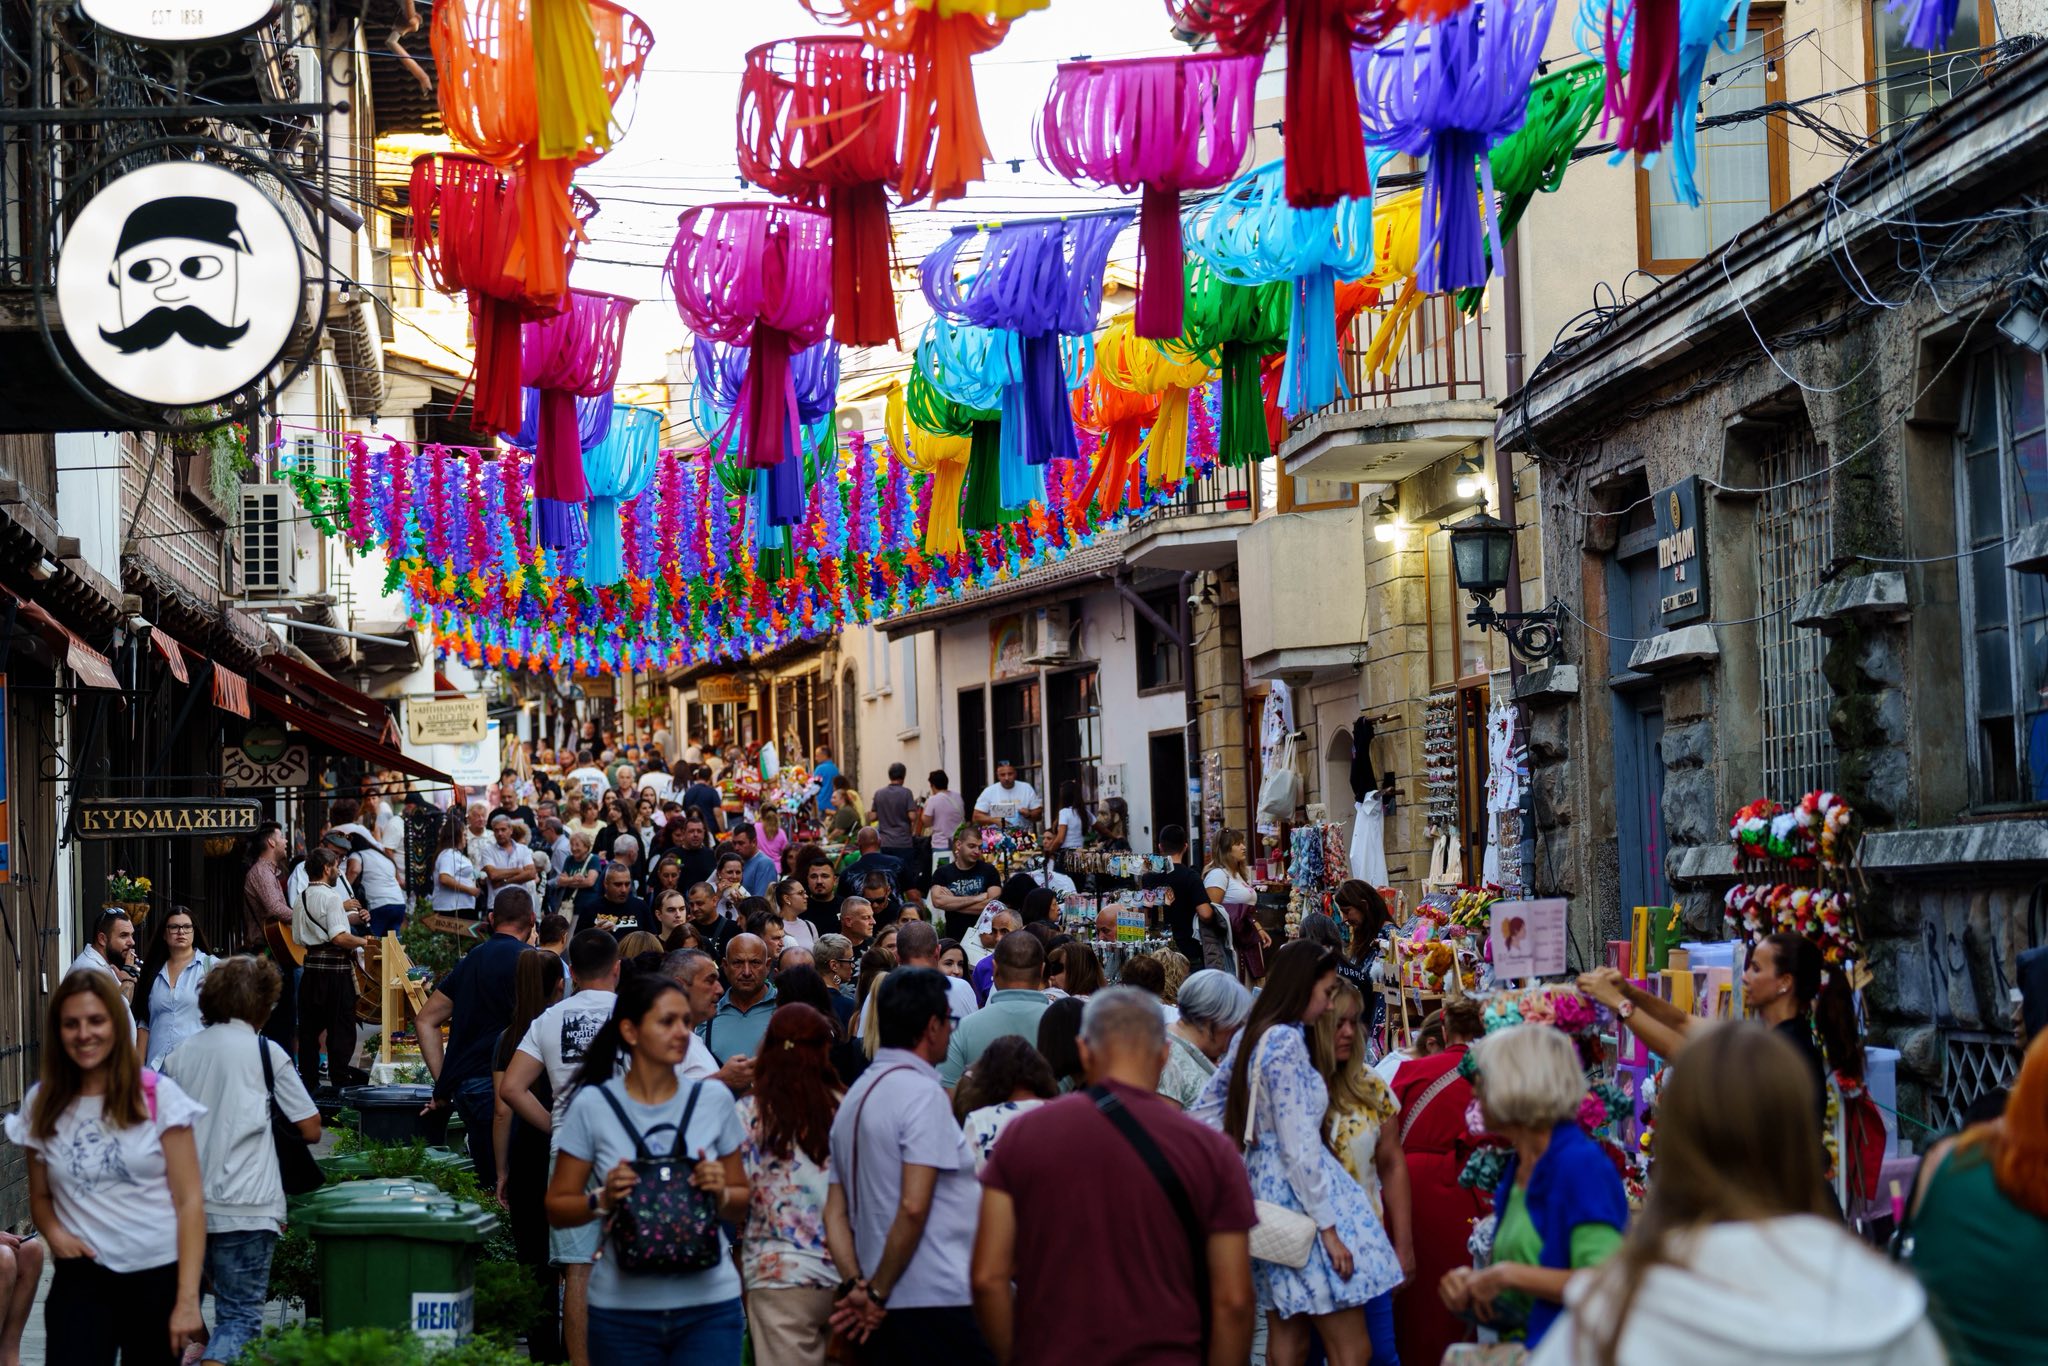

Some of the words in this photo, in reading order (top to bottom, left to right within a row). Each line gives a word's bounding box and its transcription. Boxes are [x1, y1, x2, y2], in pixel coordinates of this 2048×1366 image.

[82, 808, 258, 833] КУЮМДЖИЯ
[1338, 965, 1365, 981] PURPLE
[579, 1023, 595, 1031] THE
[566, 1030, 595, 1038] NORTH
